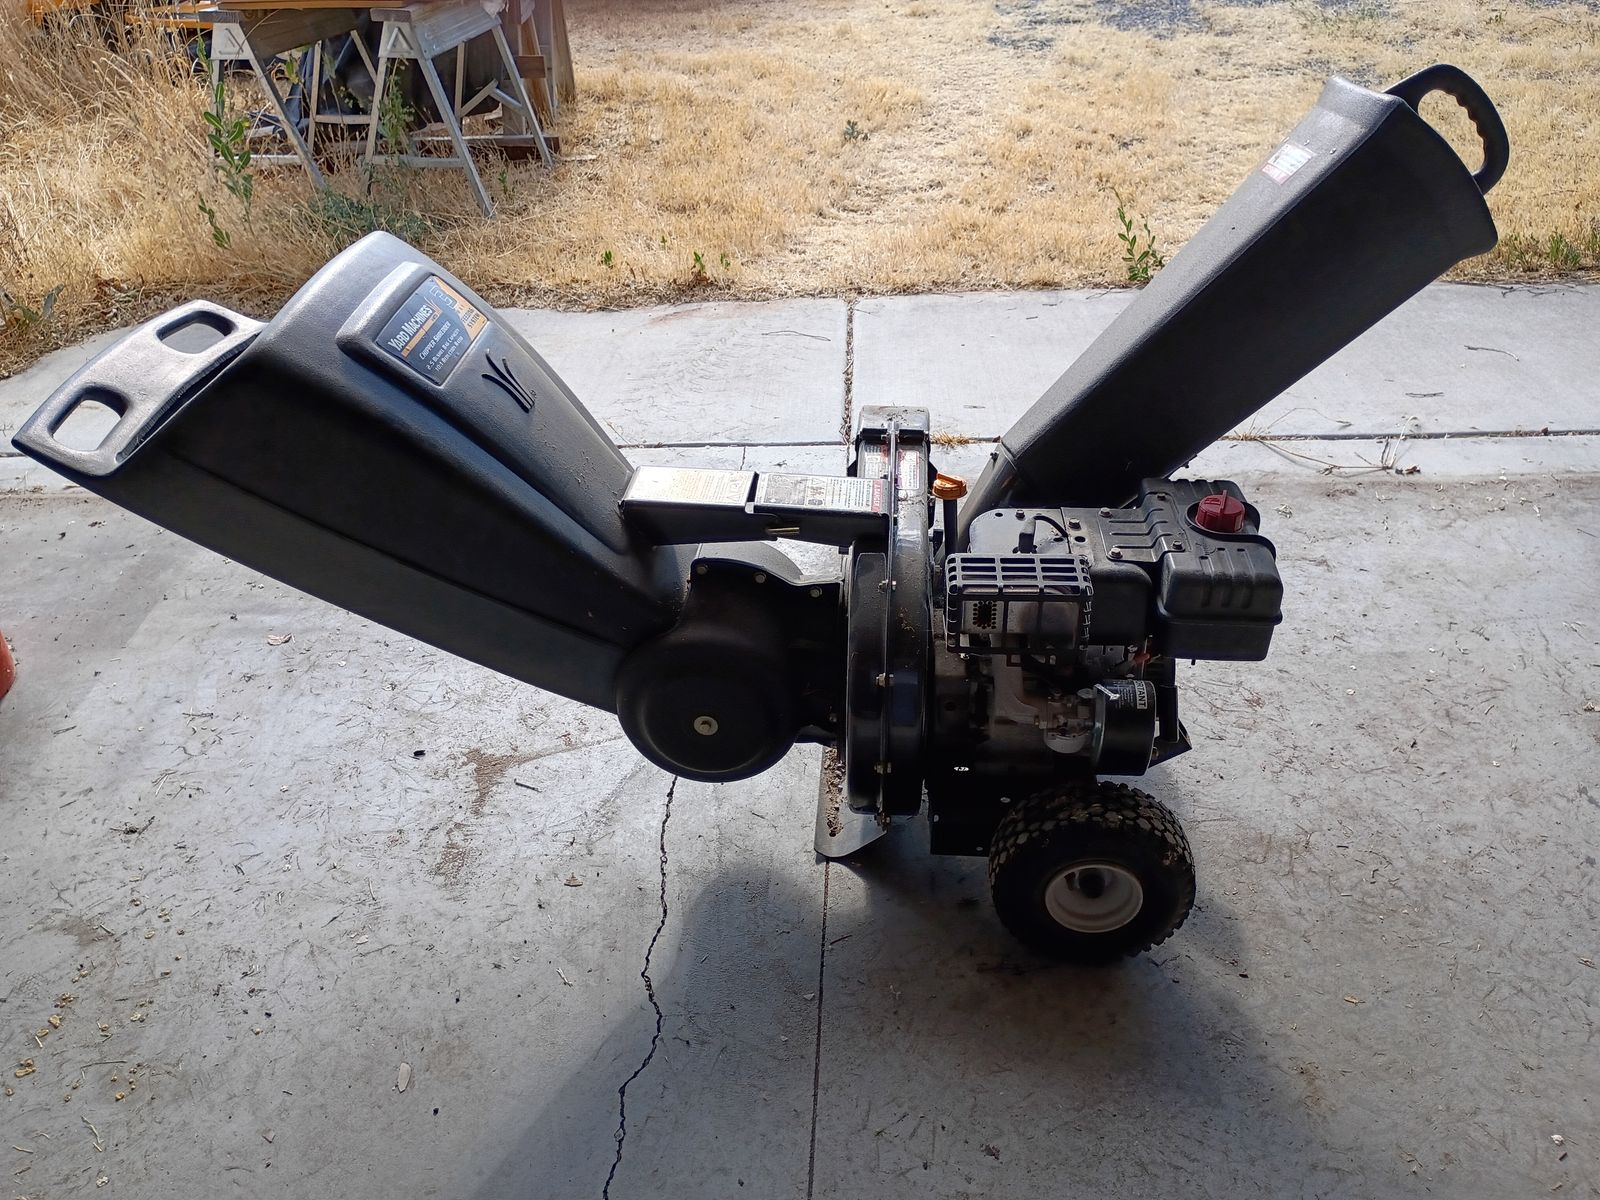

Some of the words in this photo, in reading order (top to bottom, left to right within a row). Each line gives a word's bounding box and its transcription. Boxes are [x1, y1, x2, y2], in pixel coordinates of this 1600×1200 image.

[387, 331, 410, 352] YARD
[402, 304, 433, 336] MACHINES
[419, 339, 436, 360] CHIPPER
[433, 321, 451, 342] SHREDDER
[426, 360, 435, 370] 2.5
[435, 361, 444, 371] 10:1
[1136, 680, 1146, 708] ORTANT
